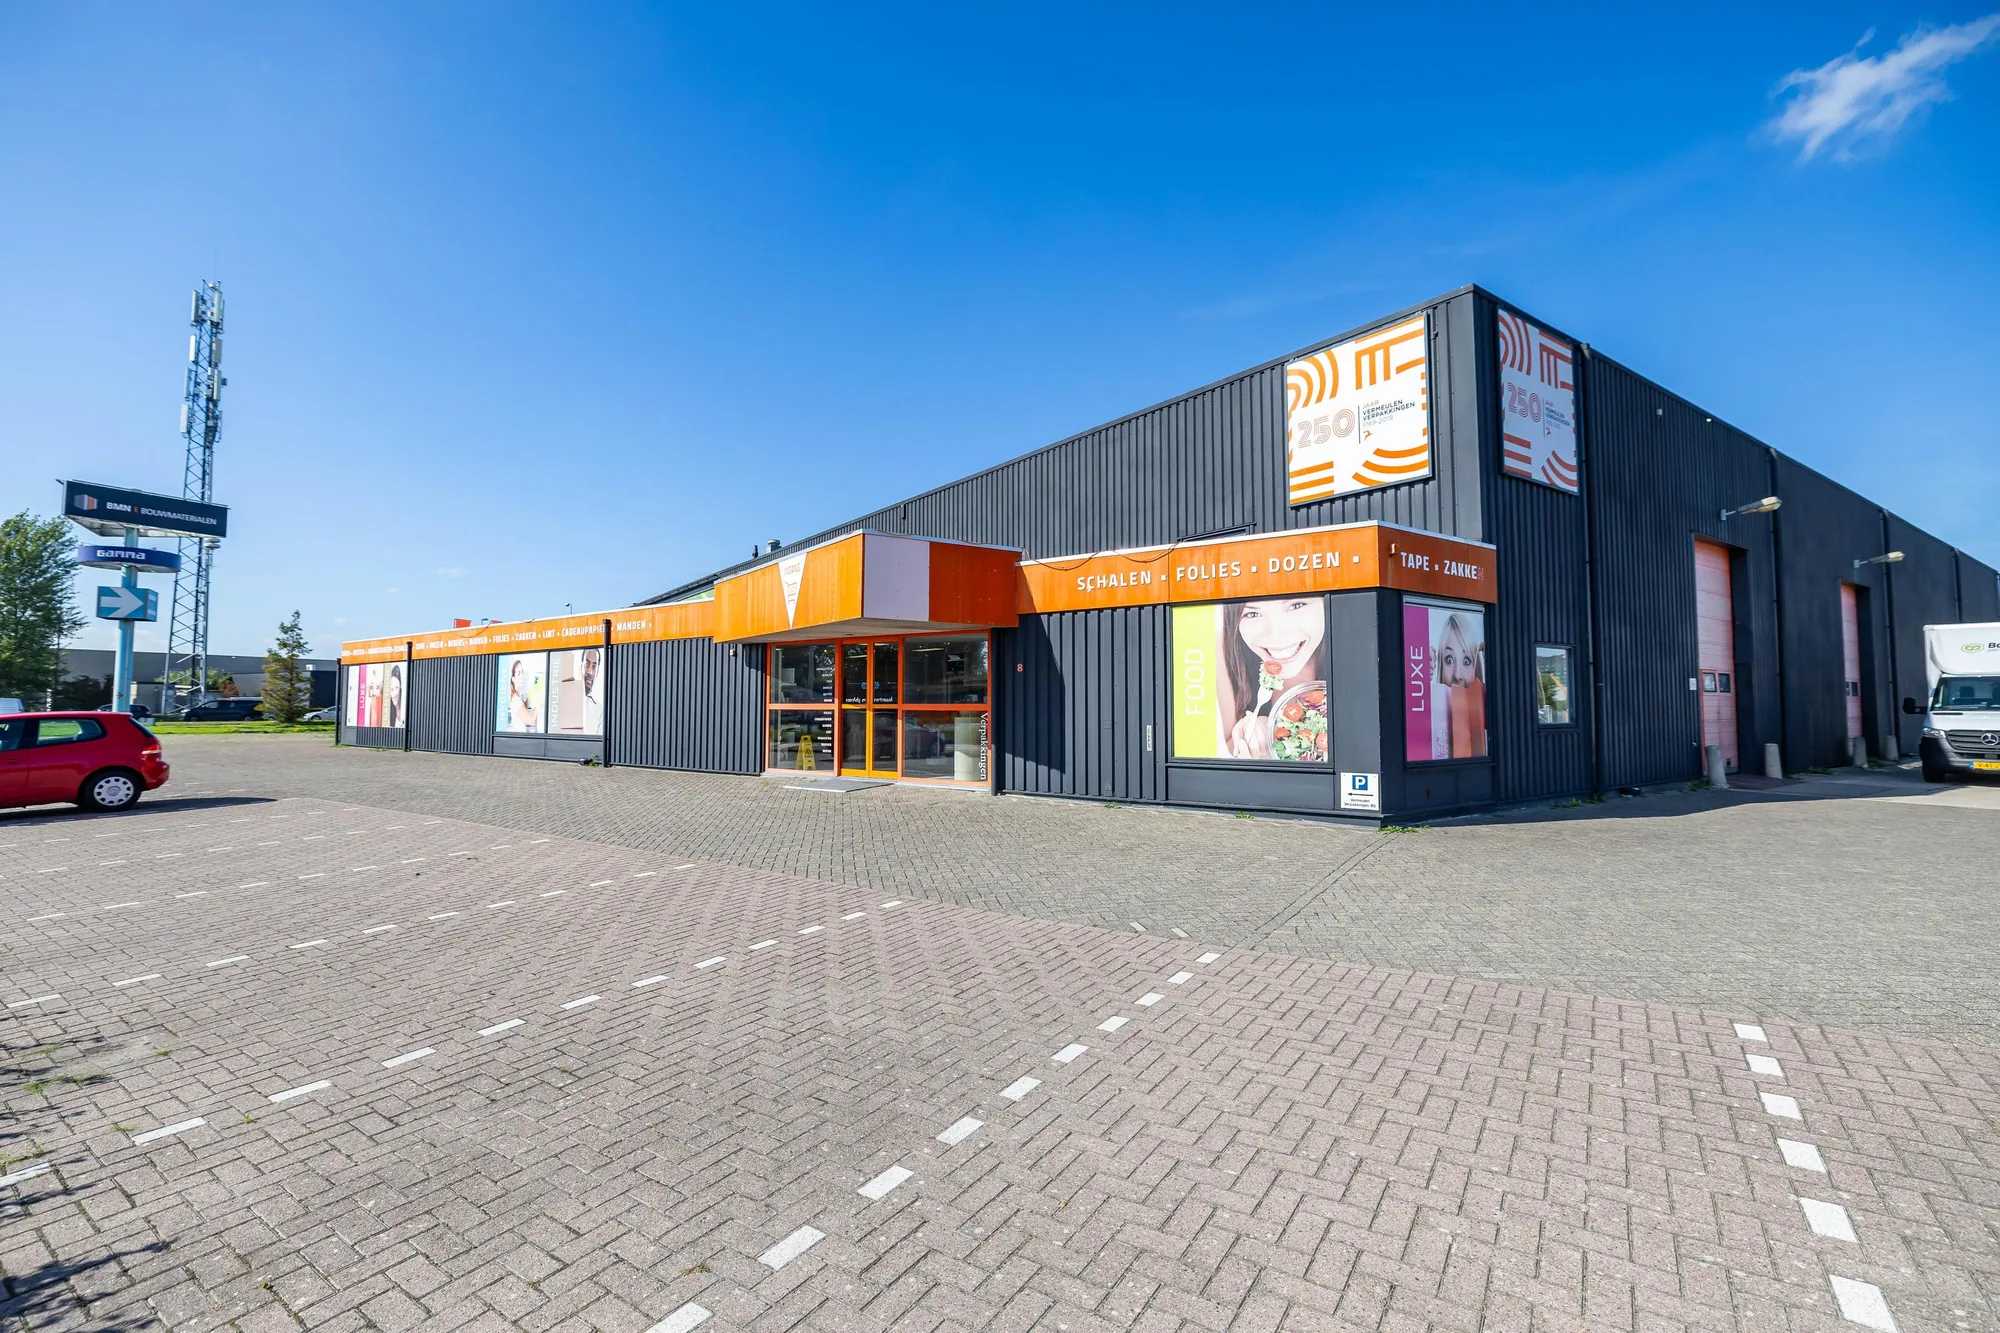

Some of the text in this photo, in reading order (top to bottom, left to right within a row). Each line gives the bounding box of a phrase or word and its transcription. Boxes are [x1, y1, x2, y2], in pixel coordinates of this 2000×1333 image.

[1363, 400, 1379, 409] JAAR
[1363, 399, 1403, 415] VERMEULEN
[1363, 401, 1415, 421] VERPAKKINGEN
[1508, 382, 1542, 423] 250
[1298, 408, 1355, 449] 250
[106, 502, 217, 525] BMN BOUWMATERIALEN
[1077, 552, 1340, 591] SCHALEN FOLIES DOZEN
[1400, 552, 1429, 571] TAPE
[493, 634, 510, 644] FOLIES
[515, 632, 537, 641] ZAKKEN
[542, 629, 555, 638] LINT
[562, 625, 603, 637] CADEAUPAPIE
[616, 621, 646, 631] MANDEN
[551, 655, 560, 727] INDUSTRIE
[1184, 649, 1205, 715] FOOD
[1410, 646, 1424, 711] LUXE
[979, 712, 989, 780] Verpakkingen
[1355, 776, 1366, 790] P
